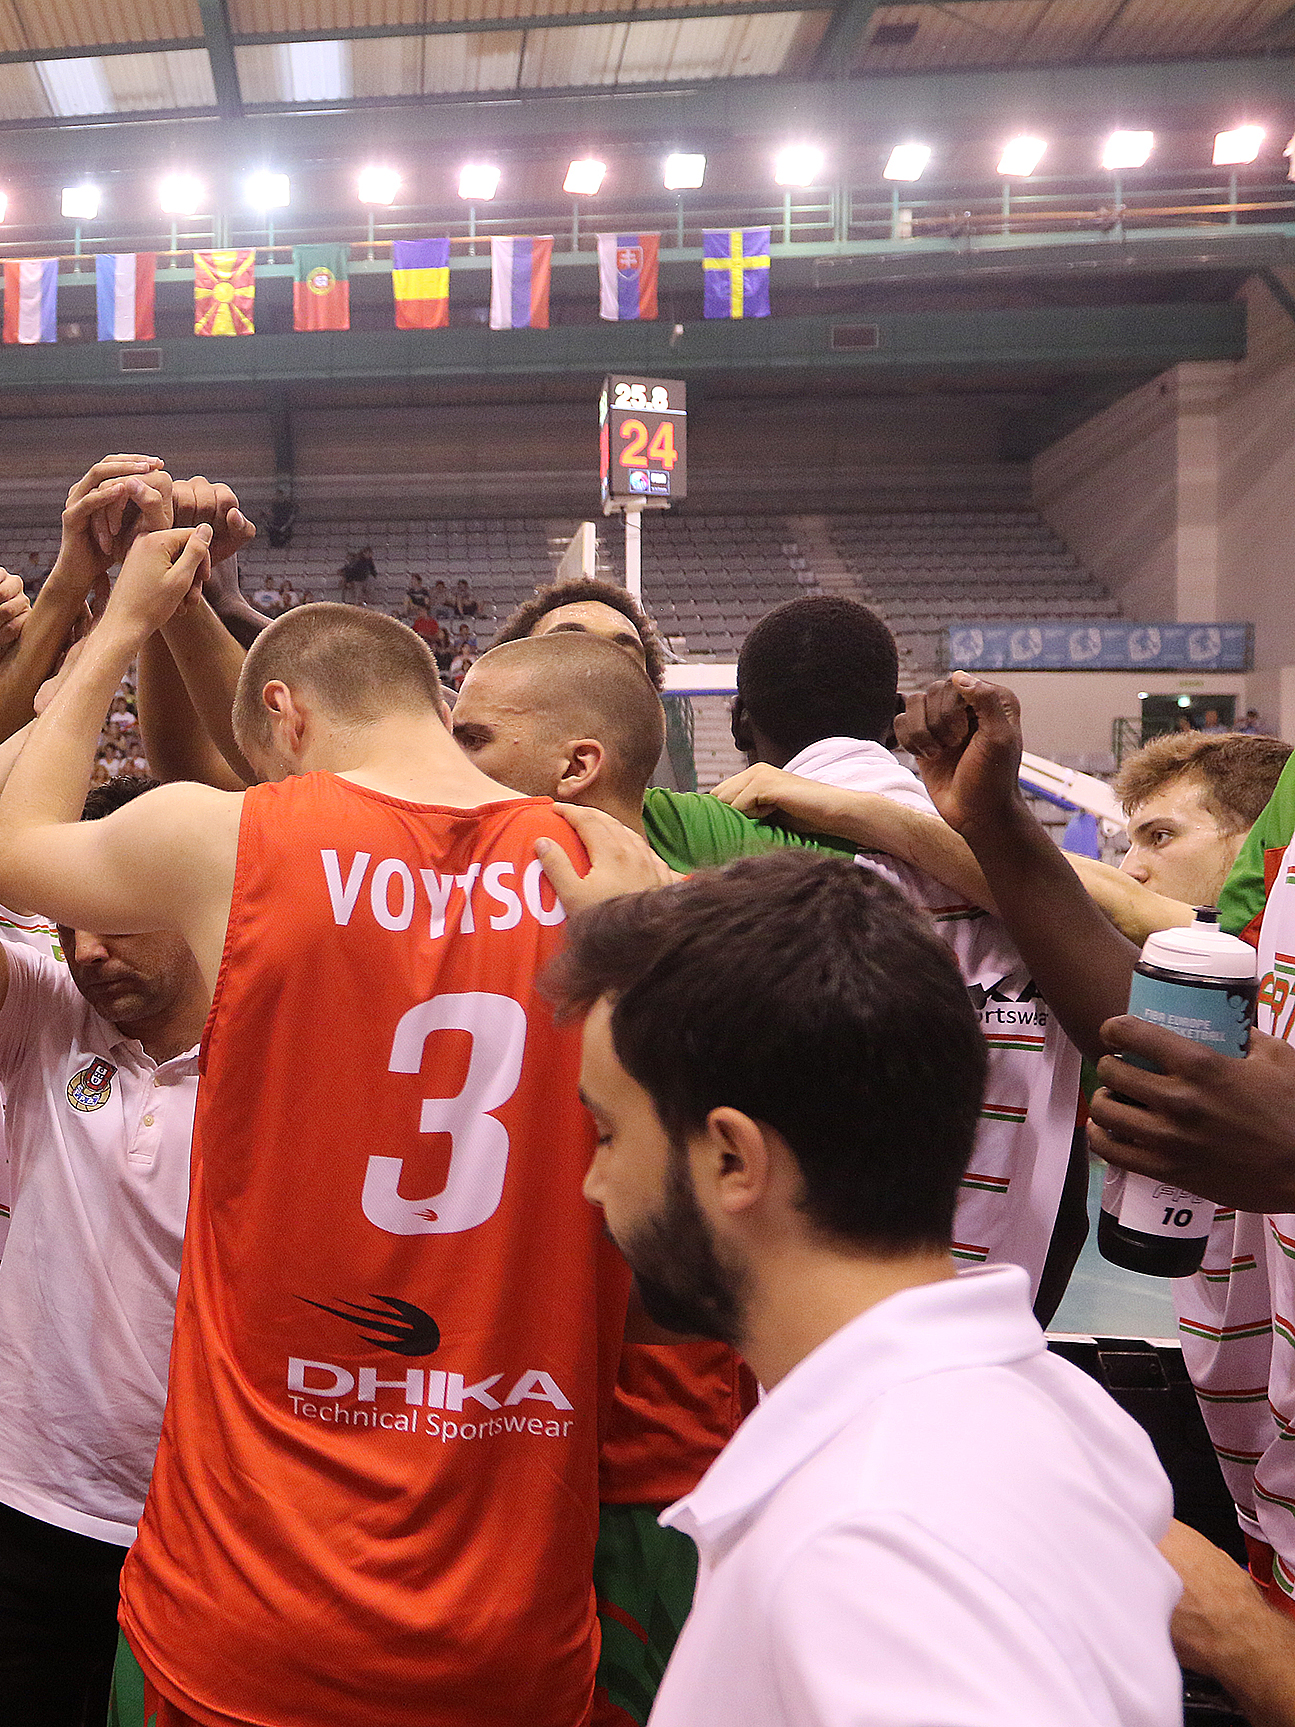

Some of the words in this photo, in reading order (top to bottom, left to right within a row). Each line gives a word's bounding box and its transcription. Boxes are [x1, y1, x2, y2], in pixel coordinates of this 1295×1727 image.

[614, 382, 669, 410] 25.8
[619, 418, 679, 471] 24
[320, 849, 567, 940] VOYTSO
[1167, 1014, 1212, 1030] EUROPE
[361, 991, 528, 1236] 3
[1162, 1207, 1194, 1228] 10
[288, 1356, 575, 1413] DHIKA
[288, 1394, 418, 1433] Technical
[425, 1412, 574, 1443] Sportswear
